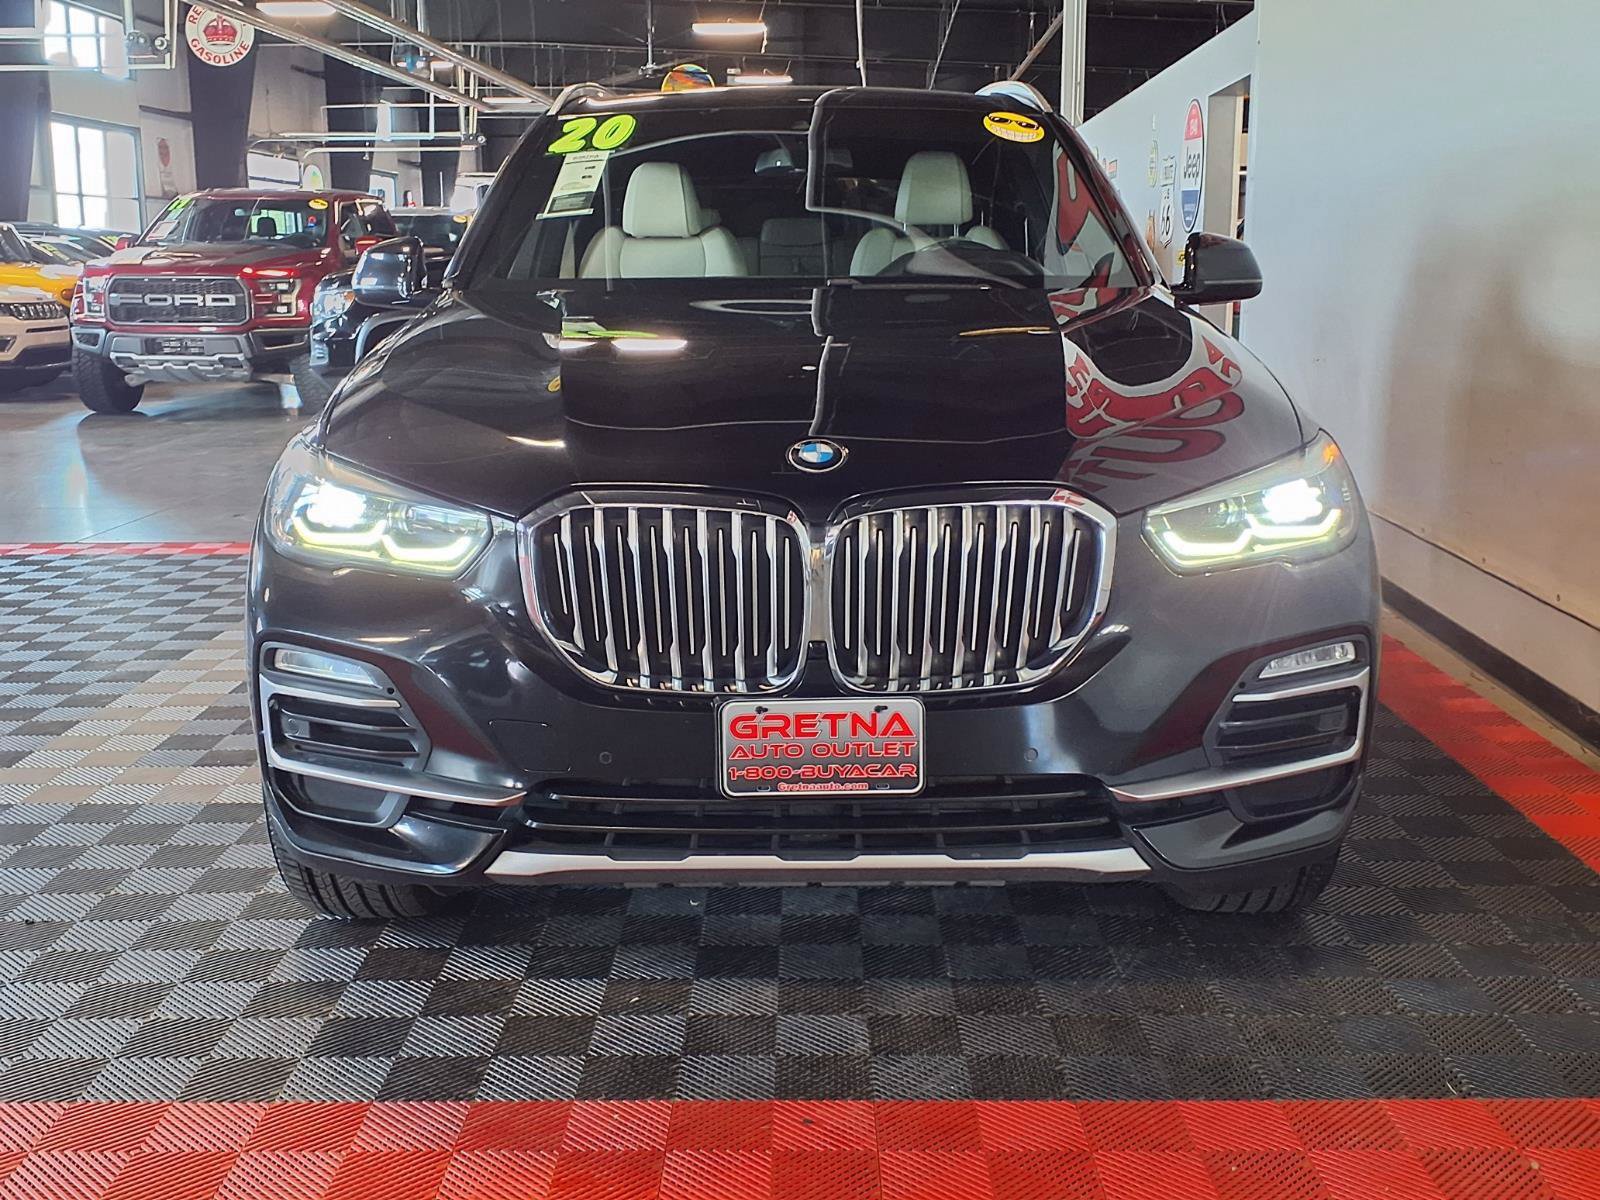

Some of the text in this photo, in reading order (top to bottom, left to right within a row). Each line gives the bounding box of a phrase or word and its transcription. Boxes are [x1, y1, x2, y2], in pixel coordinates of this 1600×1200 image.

[188, 5, 204, 24] RE
[191, 38, 250, 64] GASOLINE
[548, 114, 636, 154] 20
[1183, 146, 1200, 187] Jeep
[1161, 204, 1171, 236] 66
[110, 293, 237, 307] FORD
[729, 711, 916, 740] GRETNA
[729, 741, 917, 760] AUTO OUTLET
[728, 763, 918, 781] 1-800-BUYACAR
[777, 782, 869, 793] Gretnaauto.com
